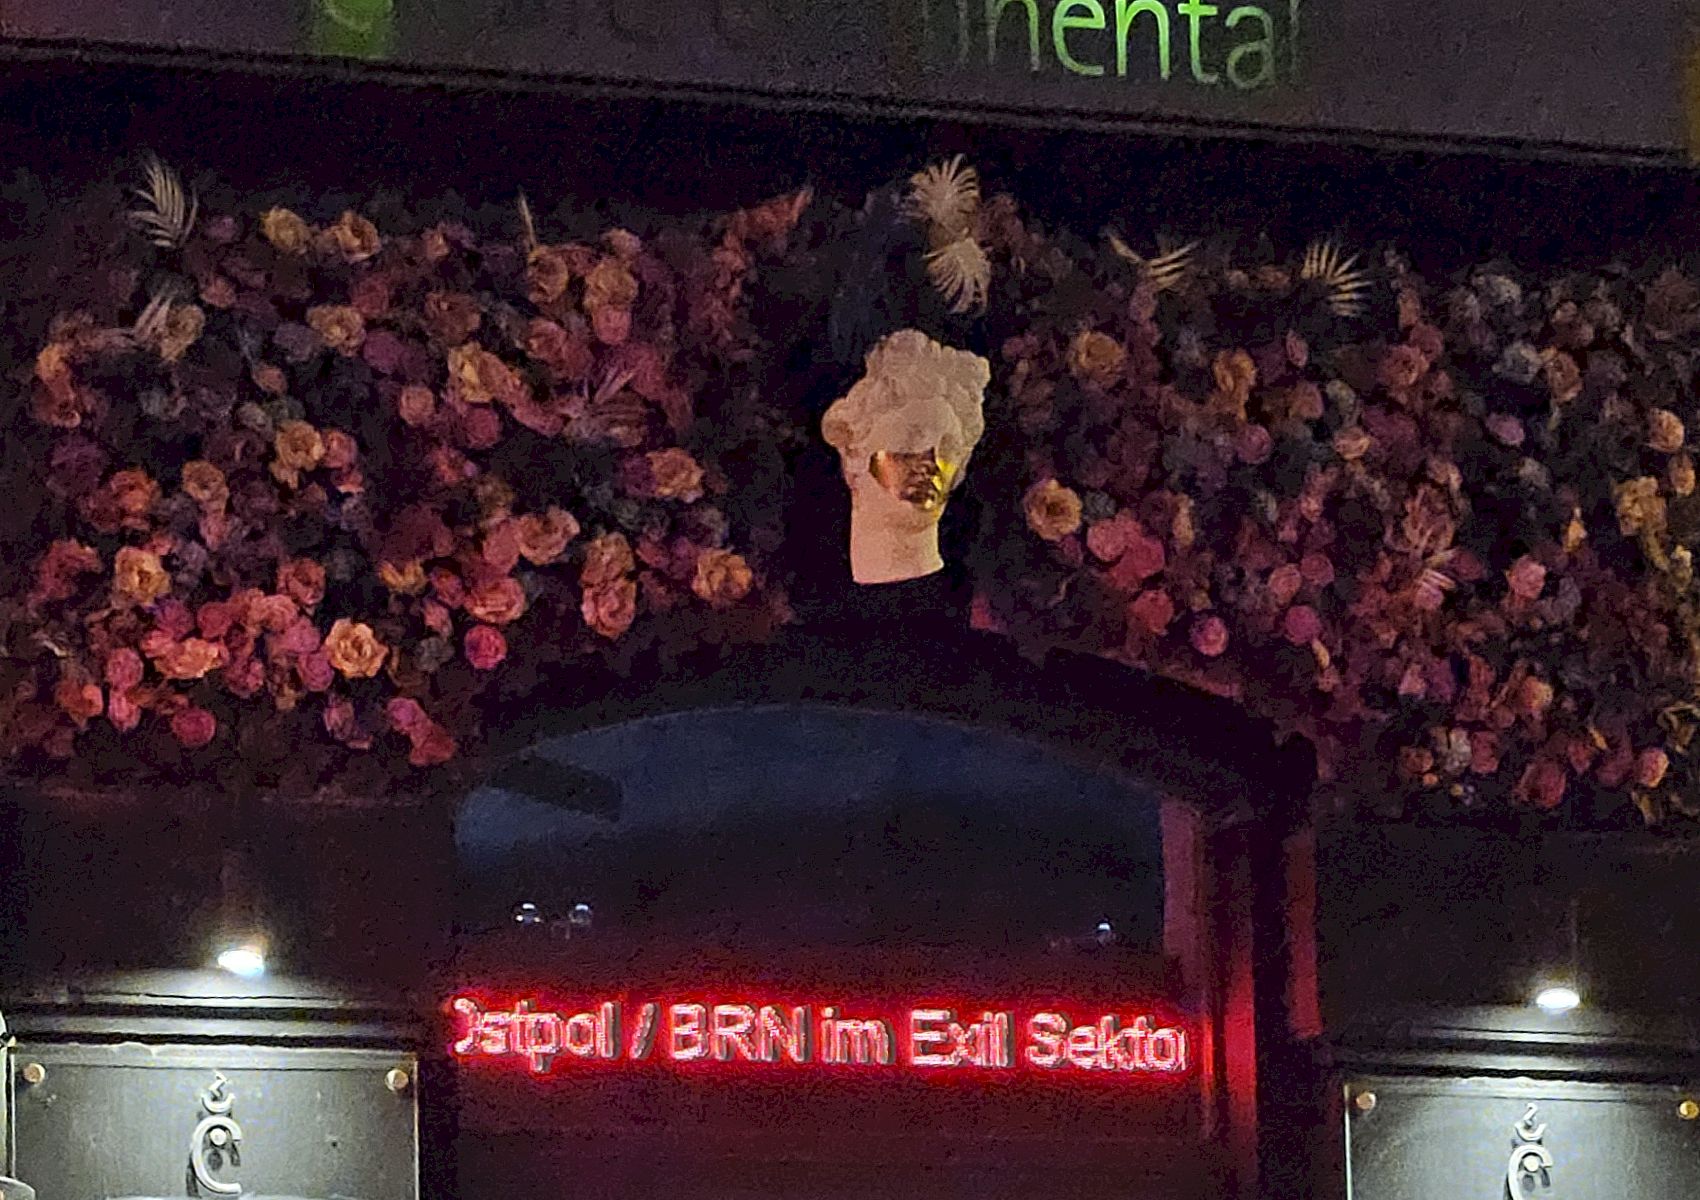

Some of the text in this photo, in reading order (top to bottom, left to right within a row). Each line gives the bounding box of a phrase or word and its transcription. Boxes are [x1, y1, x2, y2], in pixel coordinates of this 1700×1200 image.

[669, 1002, 814, 1064] BRN
[820, 1006, 895, 1066] im
[909, 1008, 1014, 1069] Exil
